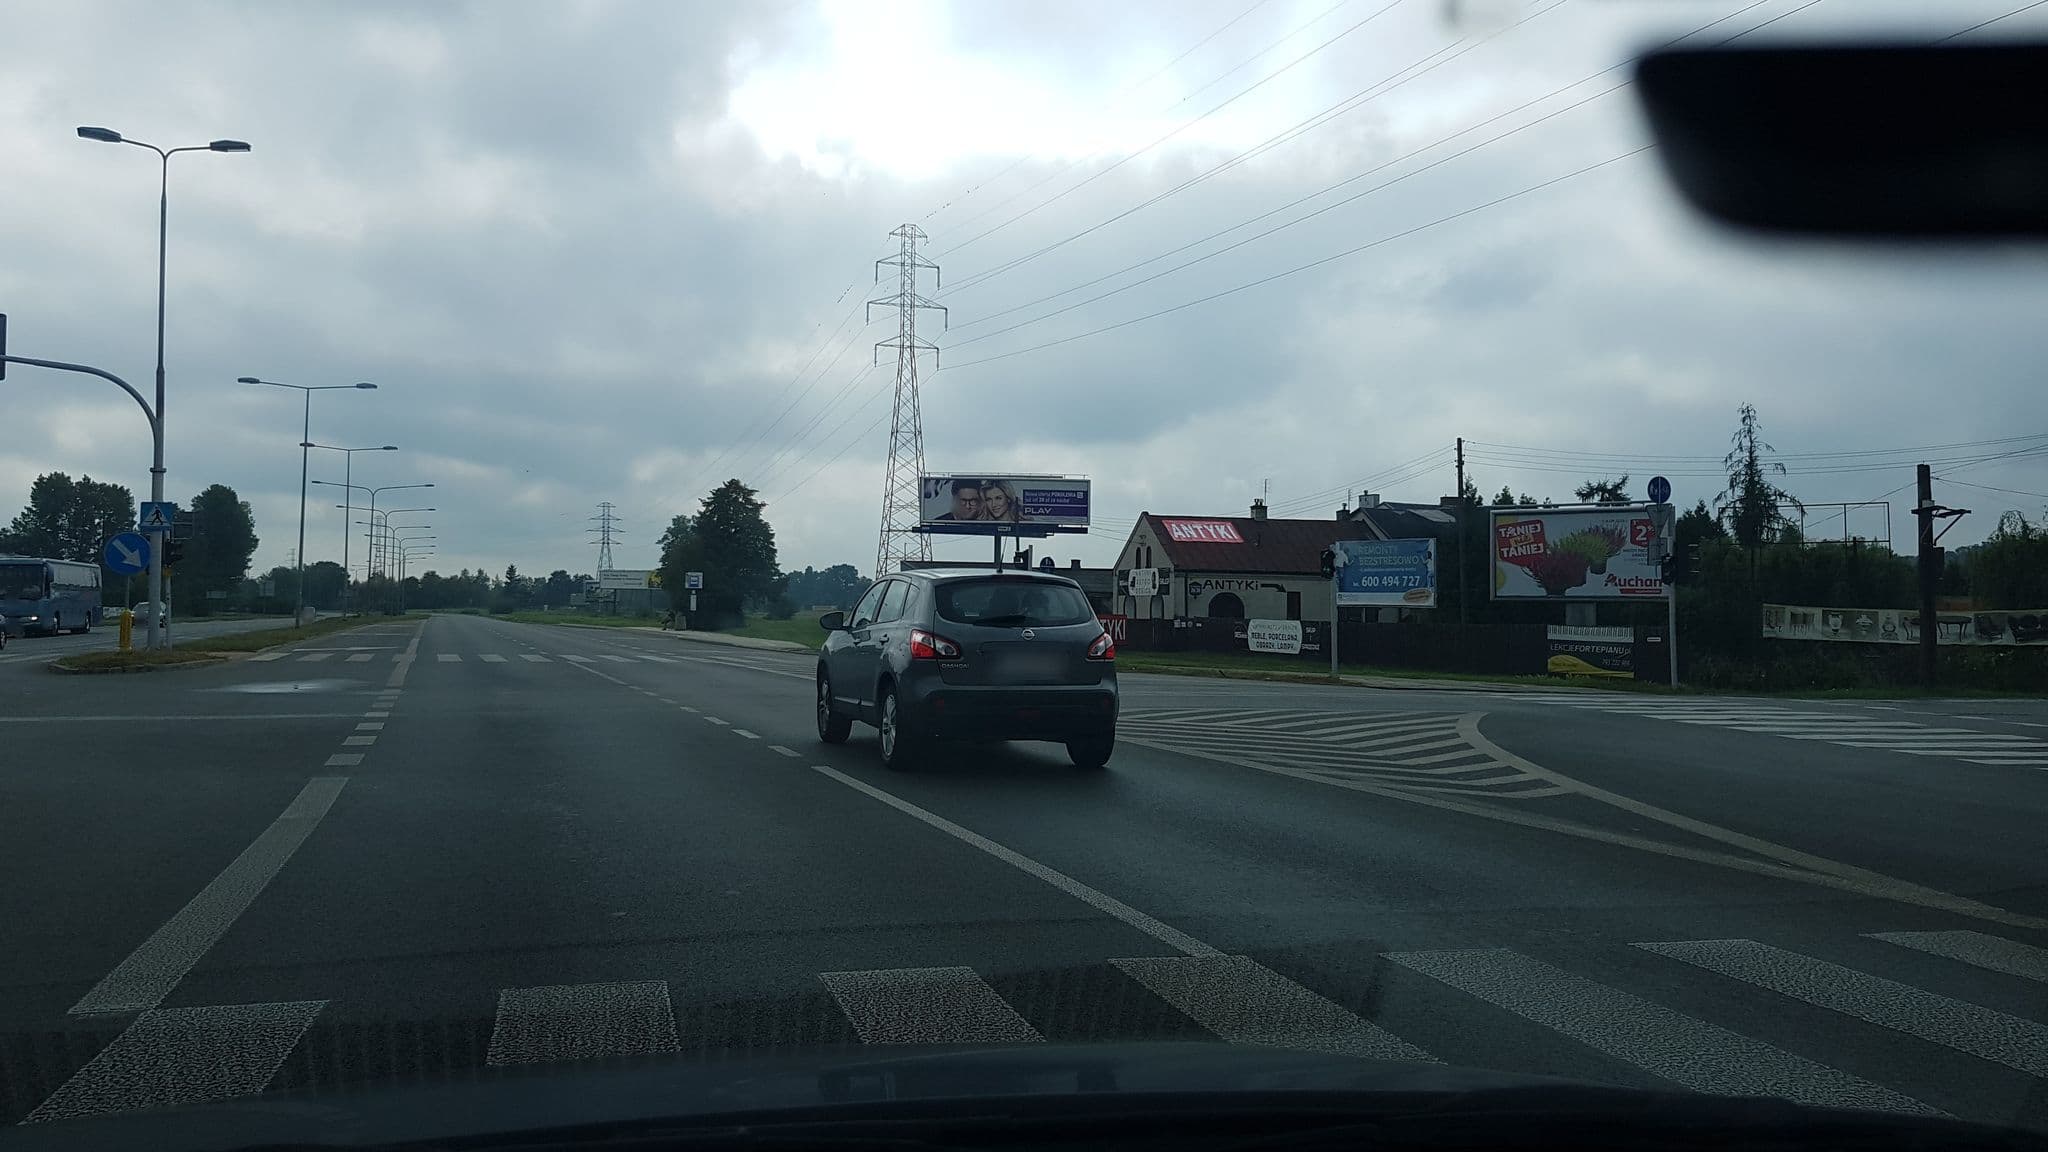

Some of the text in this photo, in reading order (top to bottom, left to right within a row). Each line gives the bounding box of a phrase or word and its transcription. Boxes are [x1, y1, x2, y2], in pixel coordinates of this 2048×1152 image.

[1171, 523, 1239, 539] ANTYKI
[1498, 523, 1541, 537] TANIEJ
[1500, 543, 1544, 558] TANIEJ
[1361, 576, 1379, 587] 600
[1381, 576, 1399, 587] 494
[1402, 575, 1420, 587] 727
[1604, 573, 1664, 587] Auchan
